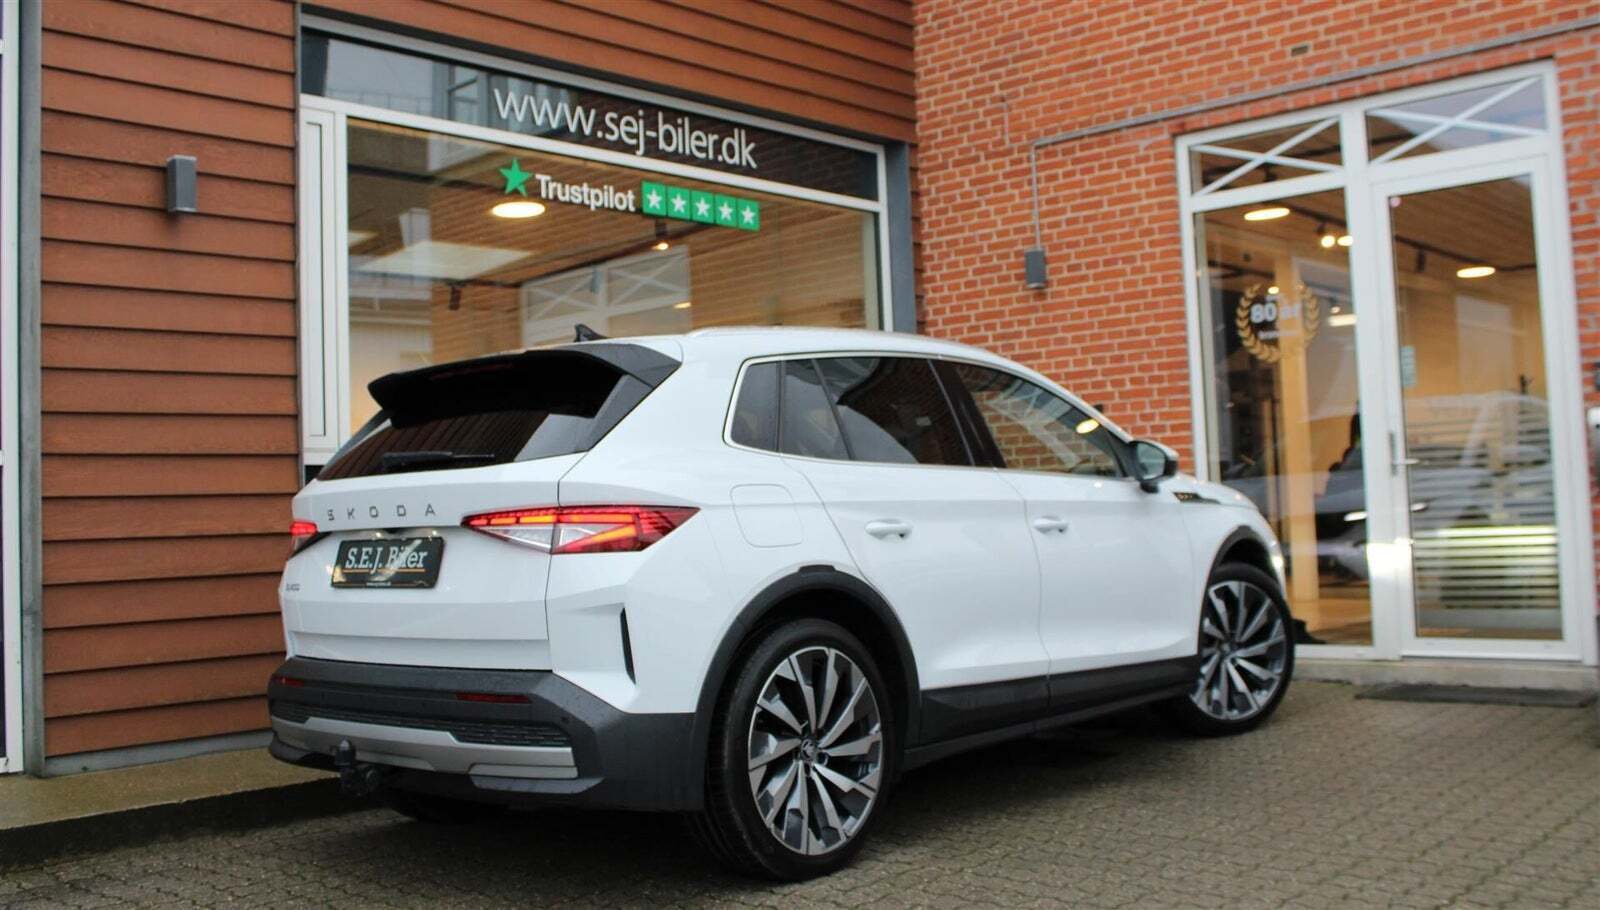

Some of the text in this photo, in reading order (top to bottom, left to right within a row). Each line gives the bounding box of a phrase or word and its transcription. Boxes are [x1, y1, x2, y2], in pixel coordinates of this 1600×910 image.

[494, 88, 757, 169] www.sej-biler.dk
[535, 174, 637, 212] Trustpilot
[1250, 303, 1277, 323] 80
[327, 504, 436, 521] SKODA
[345, 546, 428, 574] S.E.J. Biler
